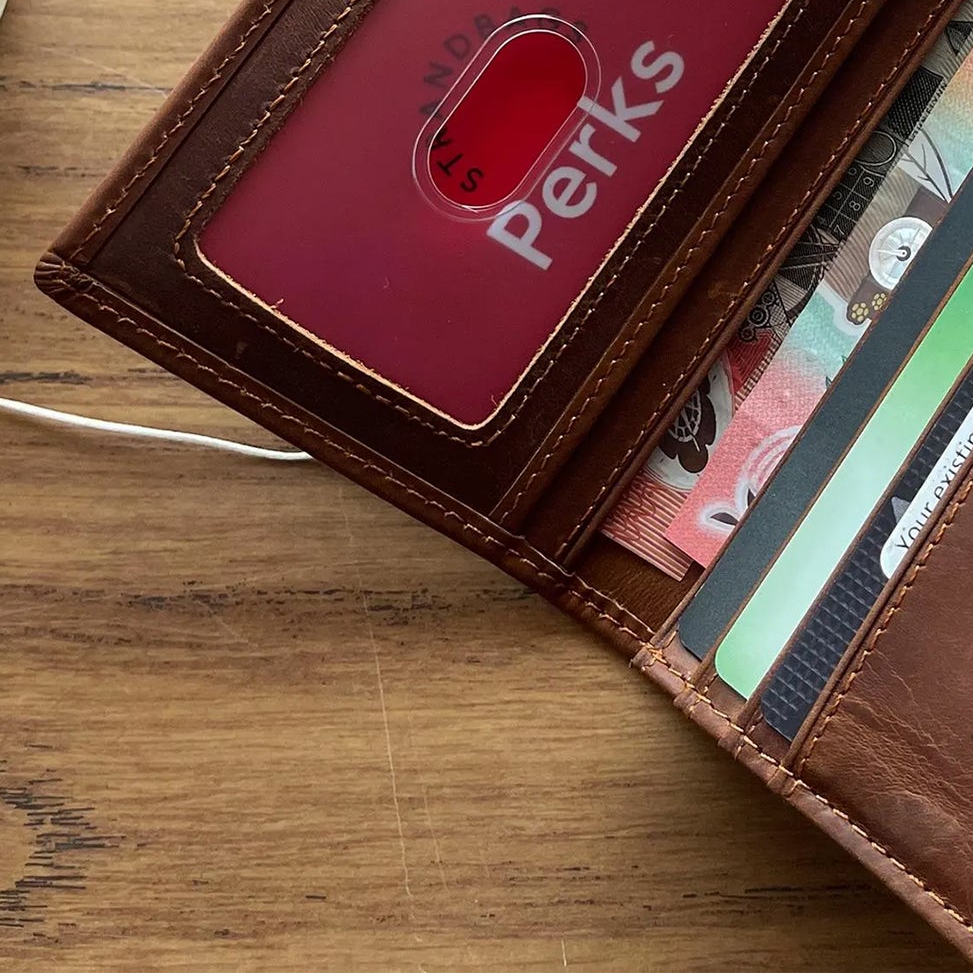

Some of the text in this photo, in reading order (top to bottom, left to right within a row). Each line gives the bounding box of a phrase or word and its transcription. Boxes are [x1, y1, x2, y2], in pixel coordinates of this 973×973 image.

[486, 39, 685, 271] Perks
[833, 176, 875, 236] 7 8 9
[895, 501, 937, 554] Your
